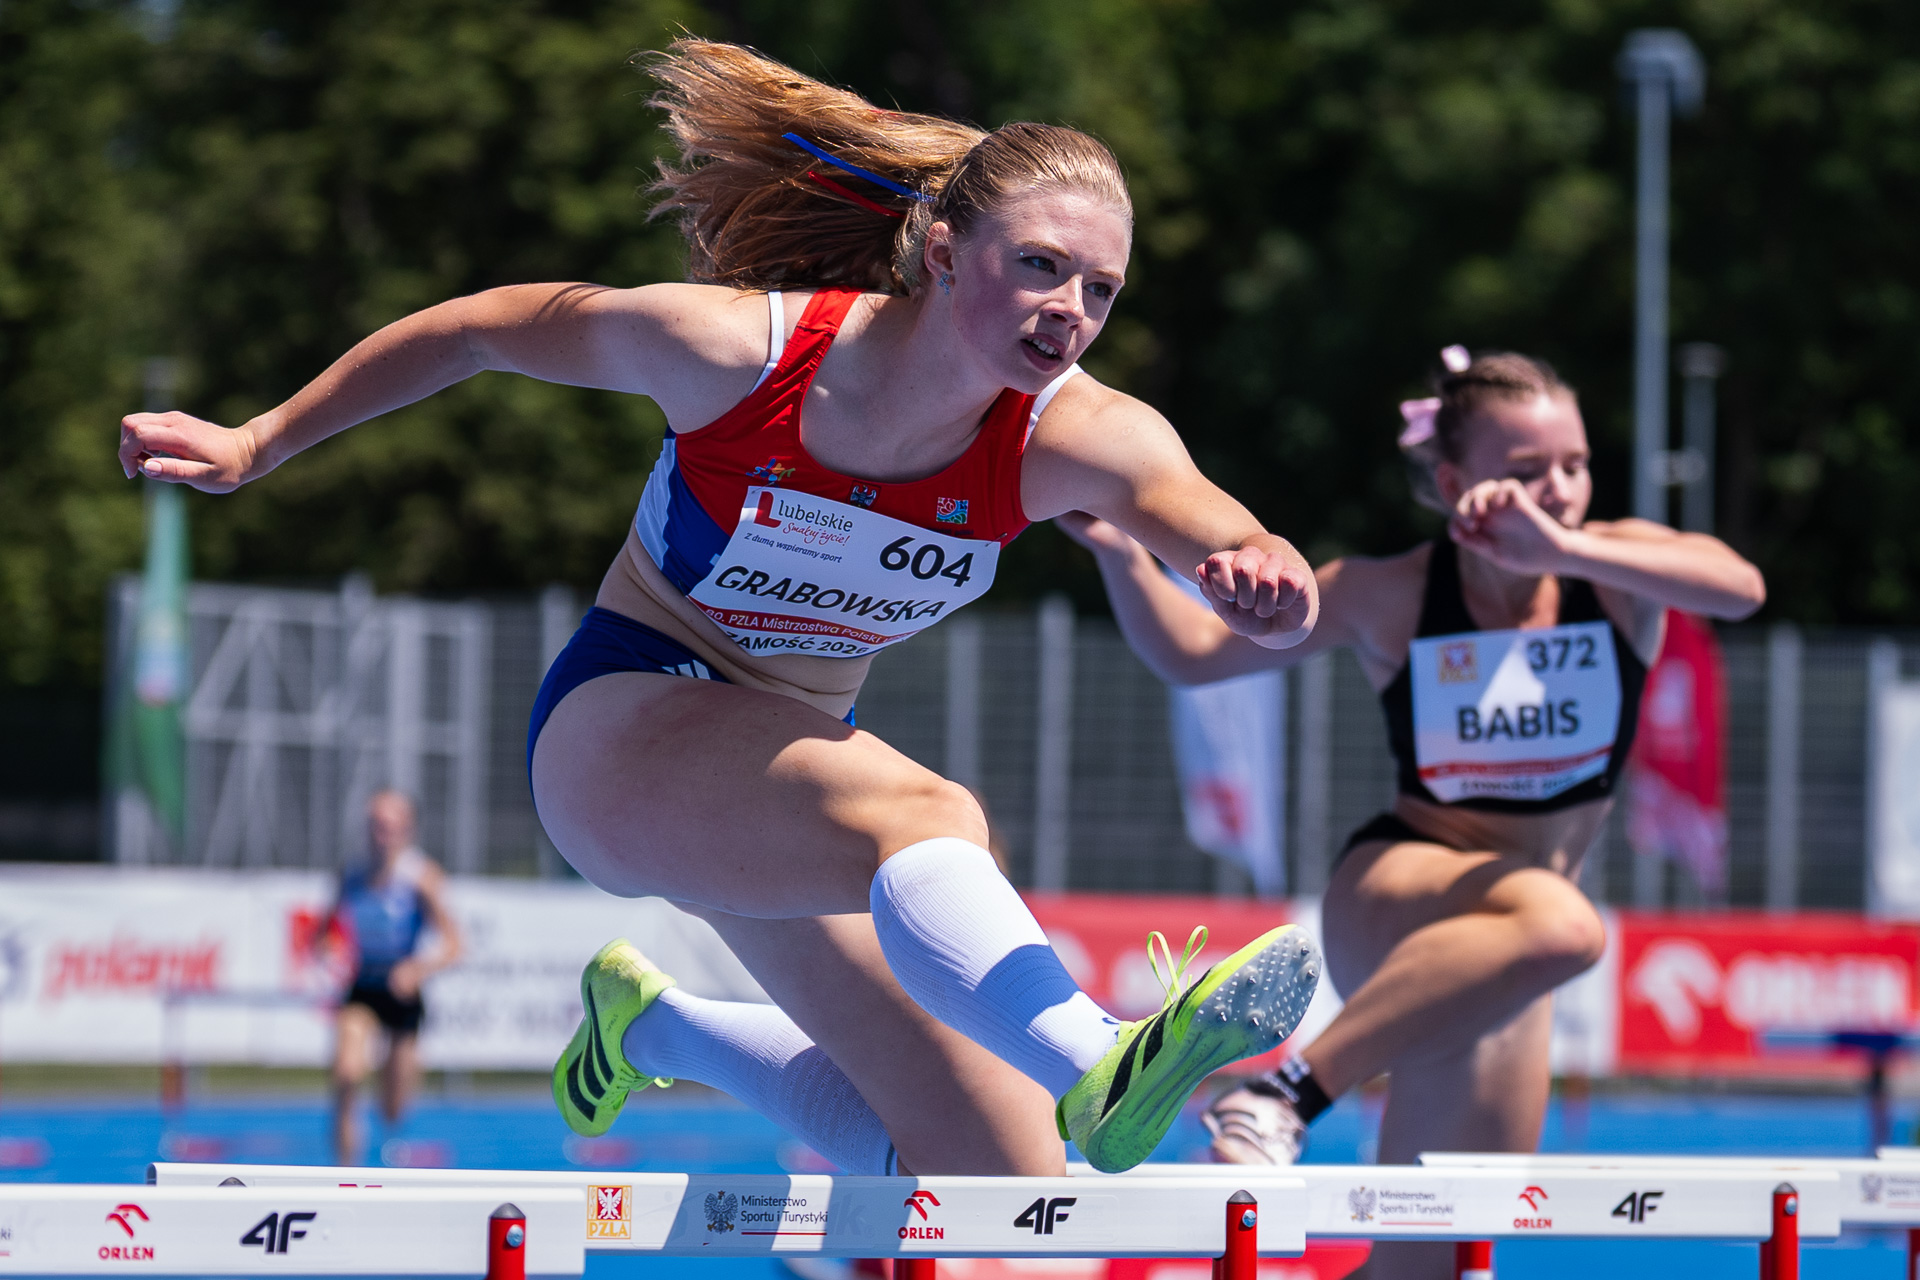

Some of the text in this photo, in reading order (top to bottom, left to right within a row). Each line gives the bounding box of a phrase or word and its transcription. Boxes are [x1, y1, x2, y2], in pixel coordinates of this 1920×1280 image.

[778, 500, 853, 532] lubelskie
[744, 532, 842, 564] Z dumą wspieramy sport
[783, 521, 851, 546] Smakuj życie!
[879, 535, 975, 588] 604
[715, 565, 948, 623] GRABOWSKA
[728, 614, 759, 628] PZLA
[761, 617, 840, 634] Mistrzostwa
[841, 627, 881, 644] Polski
[1527, 635, 1597, 672] 372
[1457, 700, 1580, 742] BABIS
[741, 1194, 807, 1207] Ministerstwo
[1013, 1197, 1078, 1235] 4F
[1611, 1191, 1664, 1223] 4F
[239, 1211, 317, 1255] 4F
[588, 1222, 628, 1237] PZLA
[740, 1210, 775, 1224] Sportu
[784, 1210, 829, 1225] Turystyki
[898, 1227, 944, 1240] ORLEN
[1514, 1218, 1552, 1229] ORLEN
[98, 1246, 154, 1261] ORLEN
